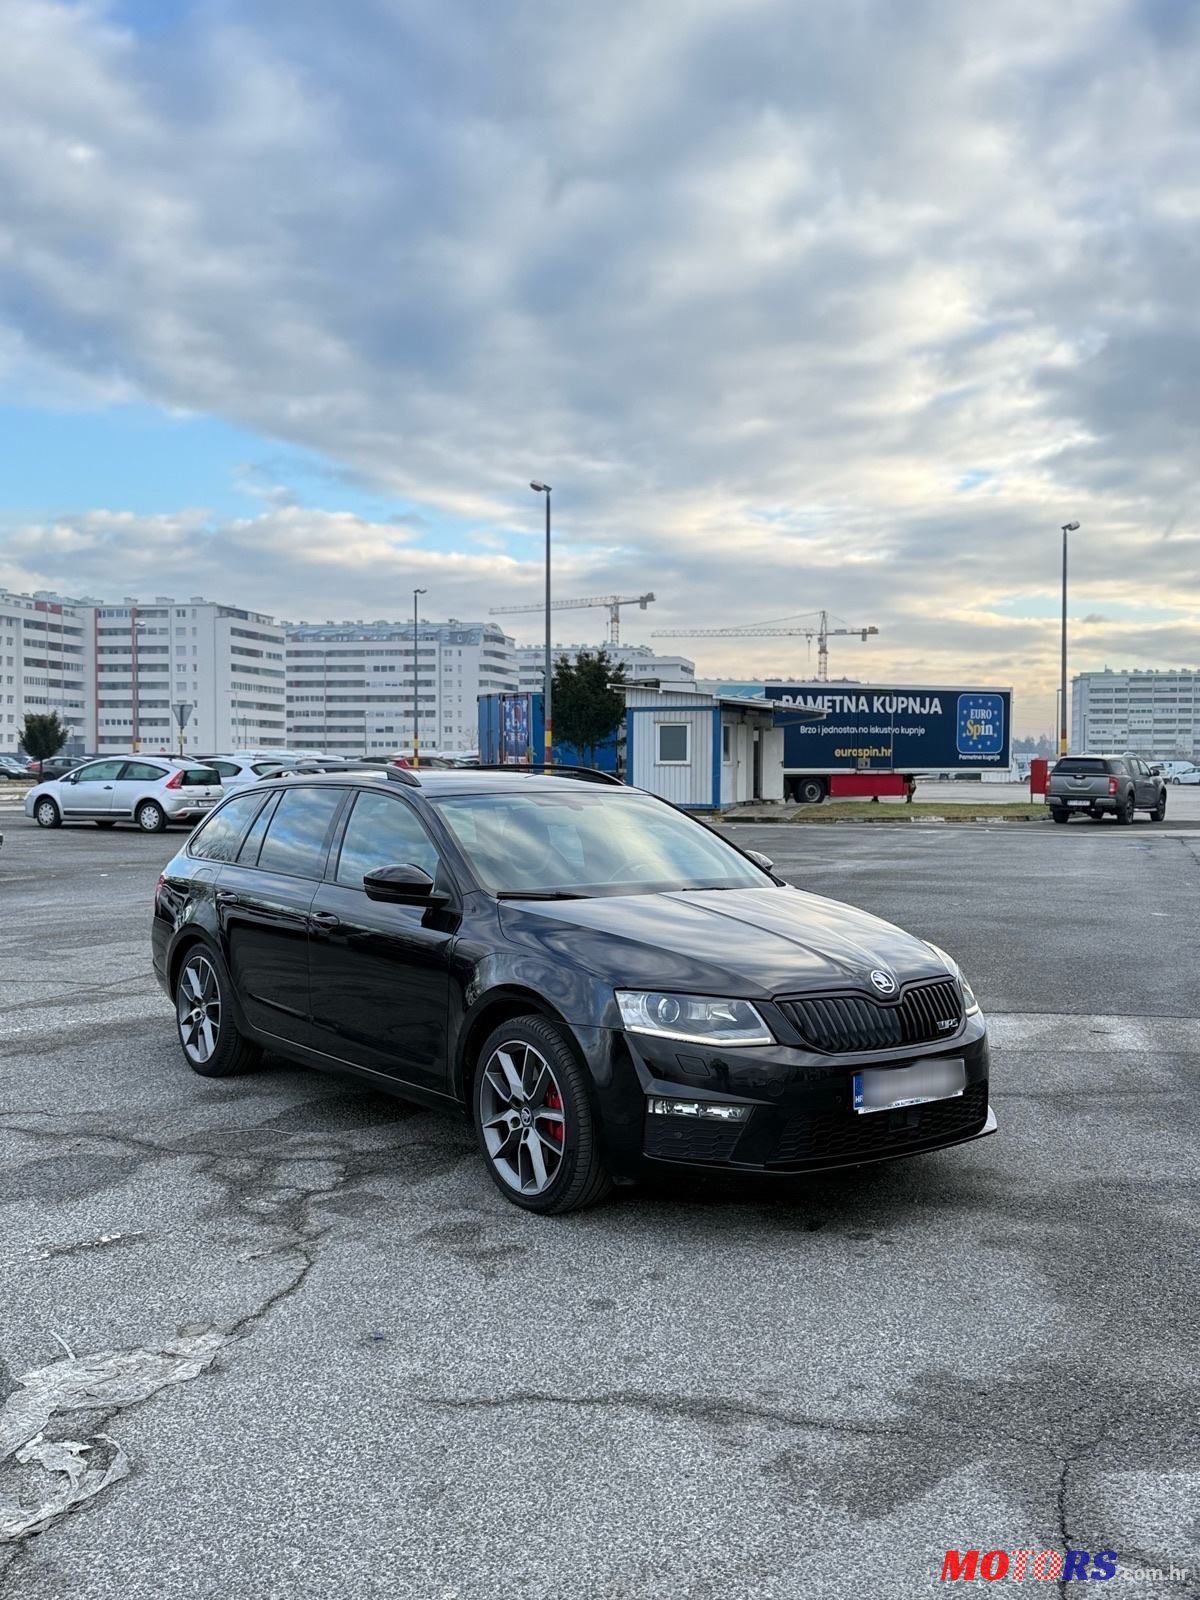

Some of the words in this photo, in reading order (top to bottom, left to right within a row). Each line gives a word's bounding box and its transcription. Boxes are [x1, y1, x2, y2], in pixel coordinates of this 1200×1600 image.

[782, 695, 869, 713] PAMETNA
[873, 696, 943, 714] KUPNJA
[970, 709, 992, 719] EURO
[800, 725, 817, 734] Brzo
[870, 725, 900, 734] iskustvo
[900, 725, 926, 737] kupnje
[966, 720, 993, 740] Spin
[834, 746, 892, 758] eurospin.hr
